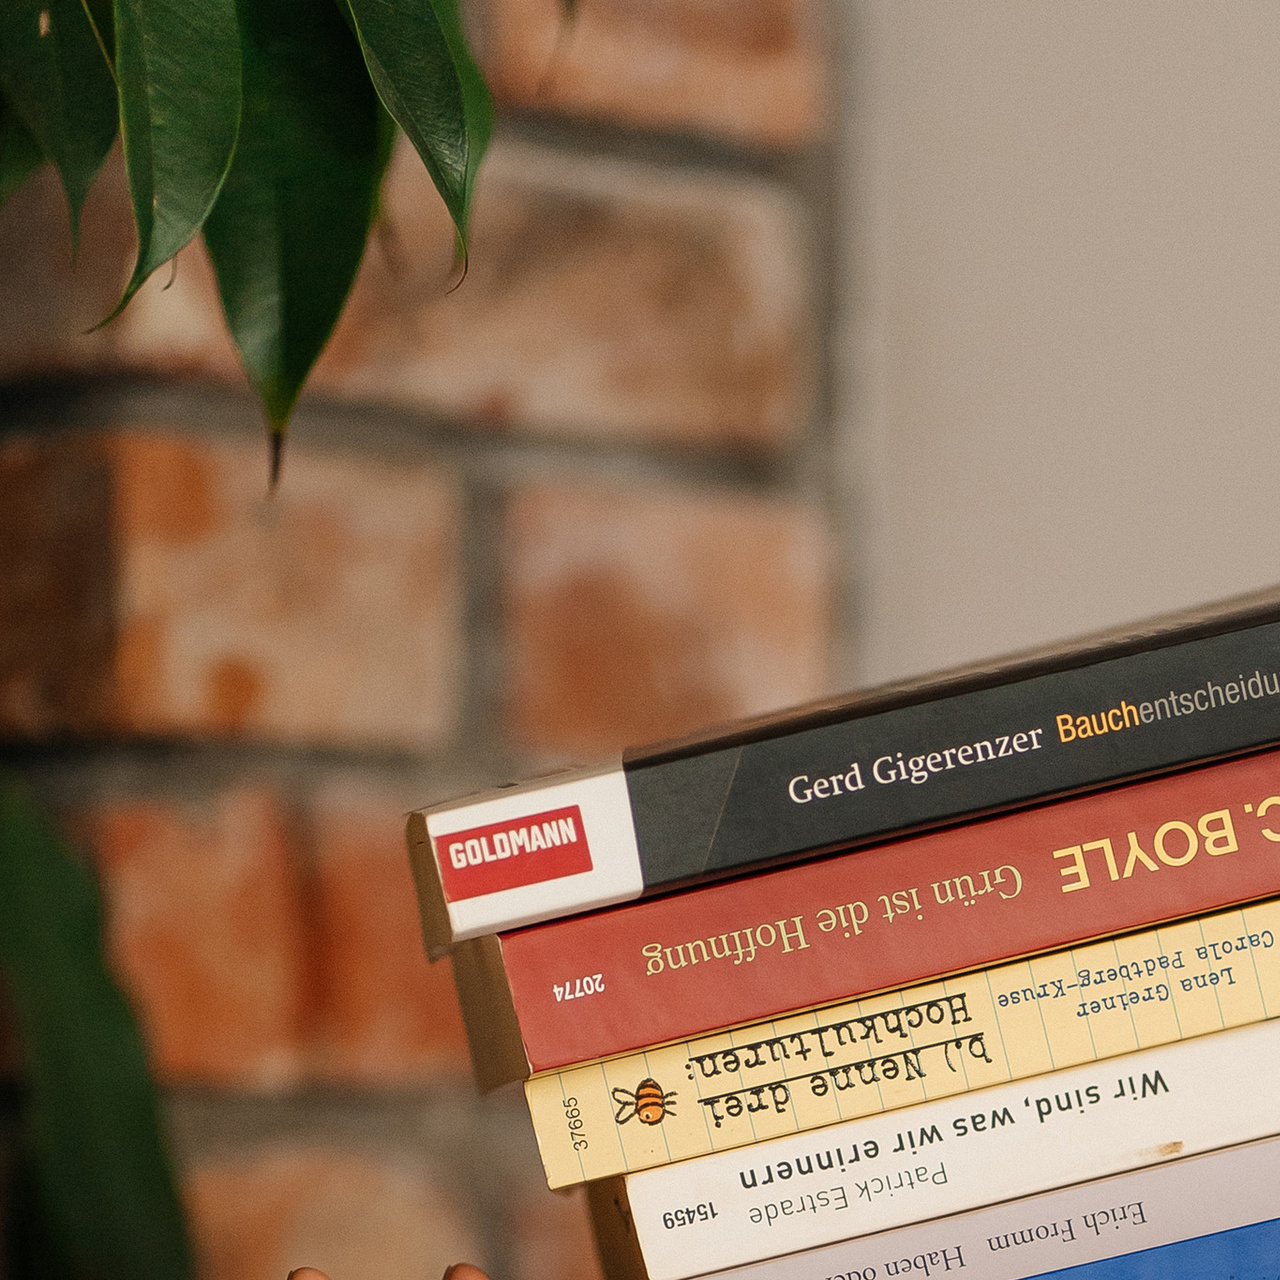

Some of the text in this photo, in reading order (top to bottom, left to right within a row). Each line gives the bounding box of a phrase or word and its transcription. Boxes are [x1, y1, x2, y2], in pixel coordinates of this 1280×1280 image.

[788, 761, 866, 804] Gerd
[872, 724, 1043, 785] Gigerenzer
[448, 816, 577, 870] GOLDMANN
[1053, 808, 1240, 894] BOYLE
[882, 884, 923, 923] ist
[933, 863, 1024, 908] Grün
[641, 915, 810, 976] Hoffnung
[816, 900, 870, 940] die
[552, 972, 605, 1003] 20774
[998, 929, 1275, 1009] Carola Padtberg-Kruse
[1076, 966, 1237, 1018] Lena Greiner
[685, 993, 973, 1082] Hochkulturen:
[709, 1034, 993, 1128] b.) Nenne drei
[561, 1096, 588, 1151] 37665
[738, 1069, 1170, 1190] Wir sind, was wir erinnern
[662, 1201, 718, 1230] 15459
[748, 1161, 948, 1226] Patrick Estrade
[1084, 1199, 1148, 1237] Erich
[884, 1244, 966, 1280] Haben
[987, 1216, 1076, 1254] Fromm
